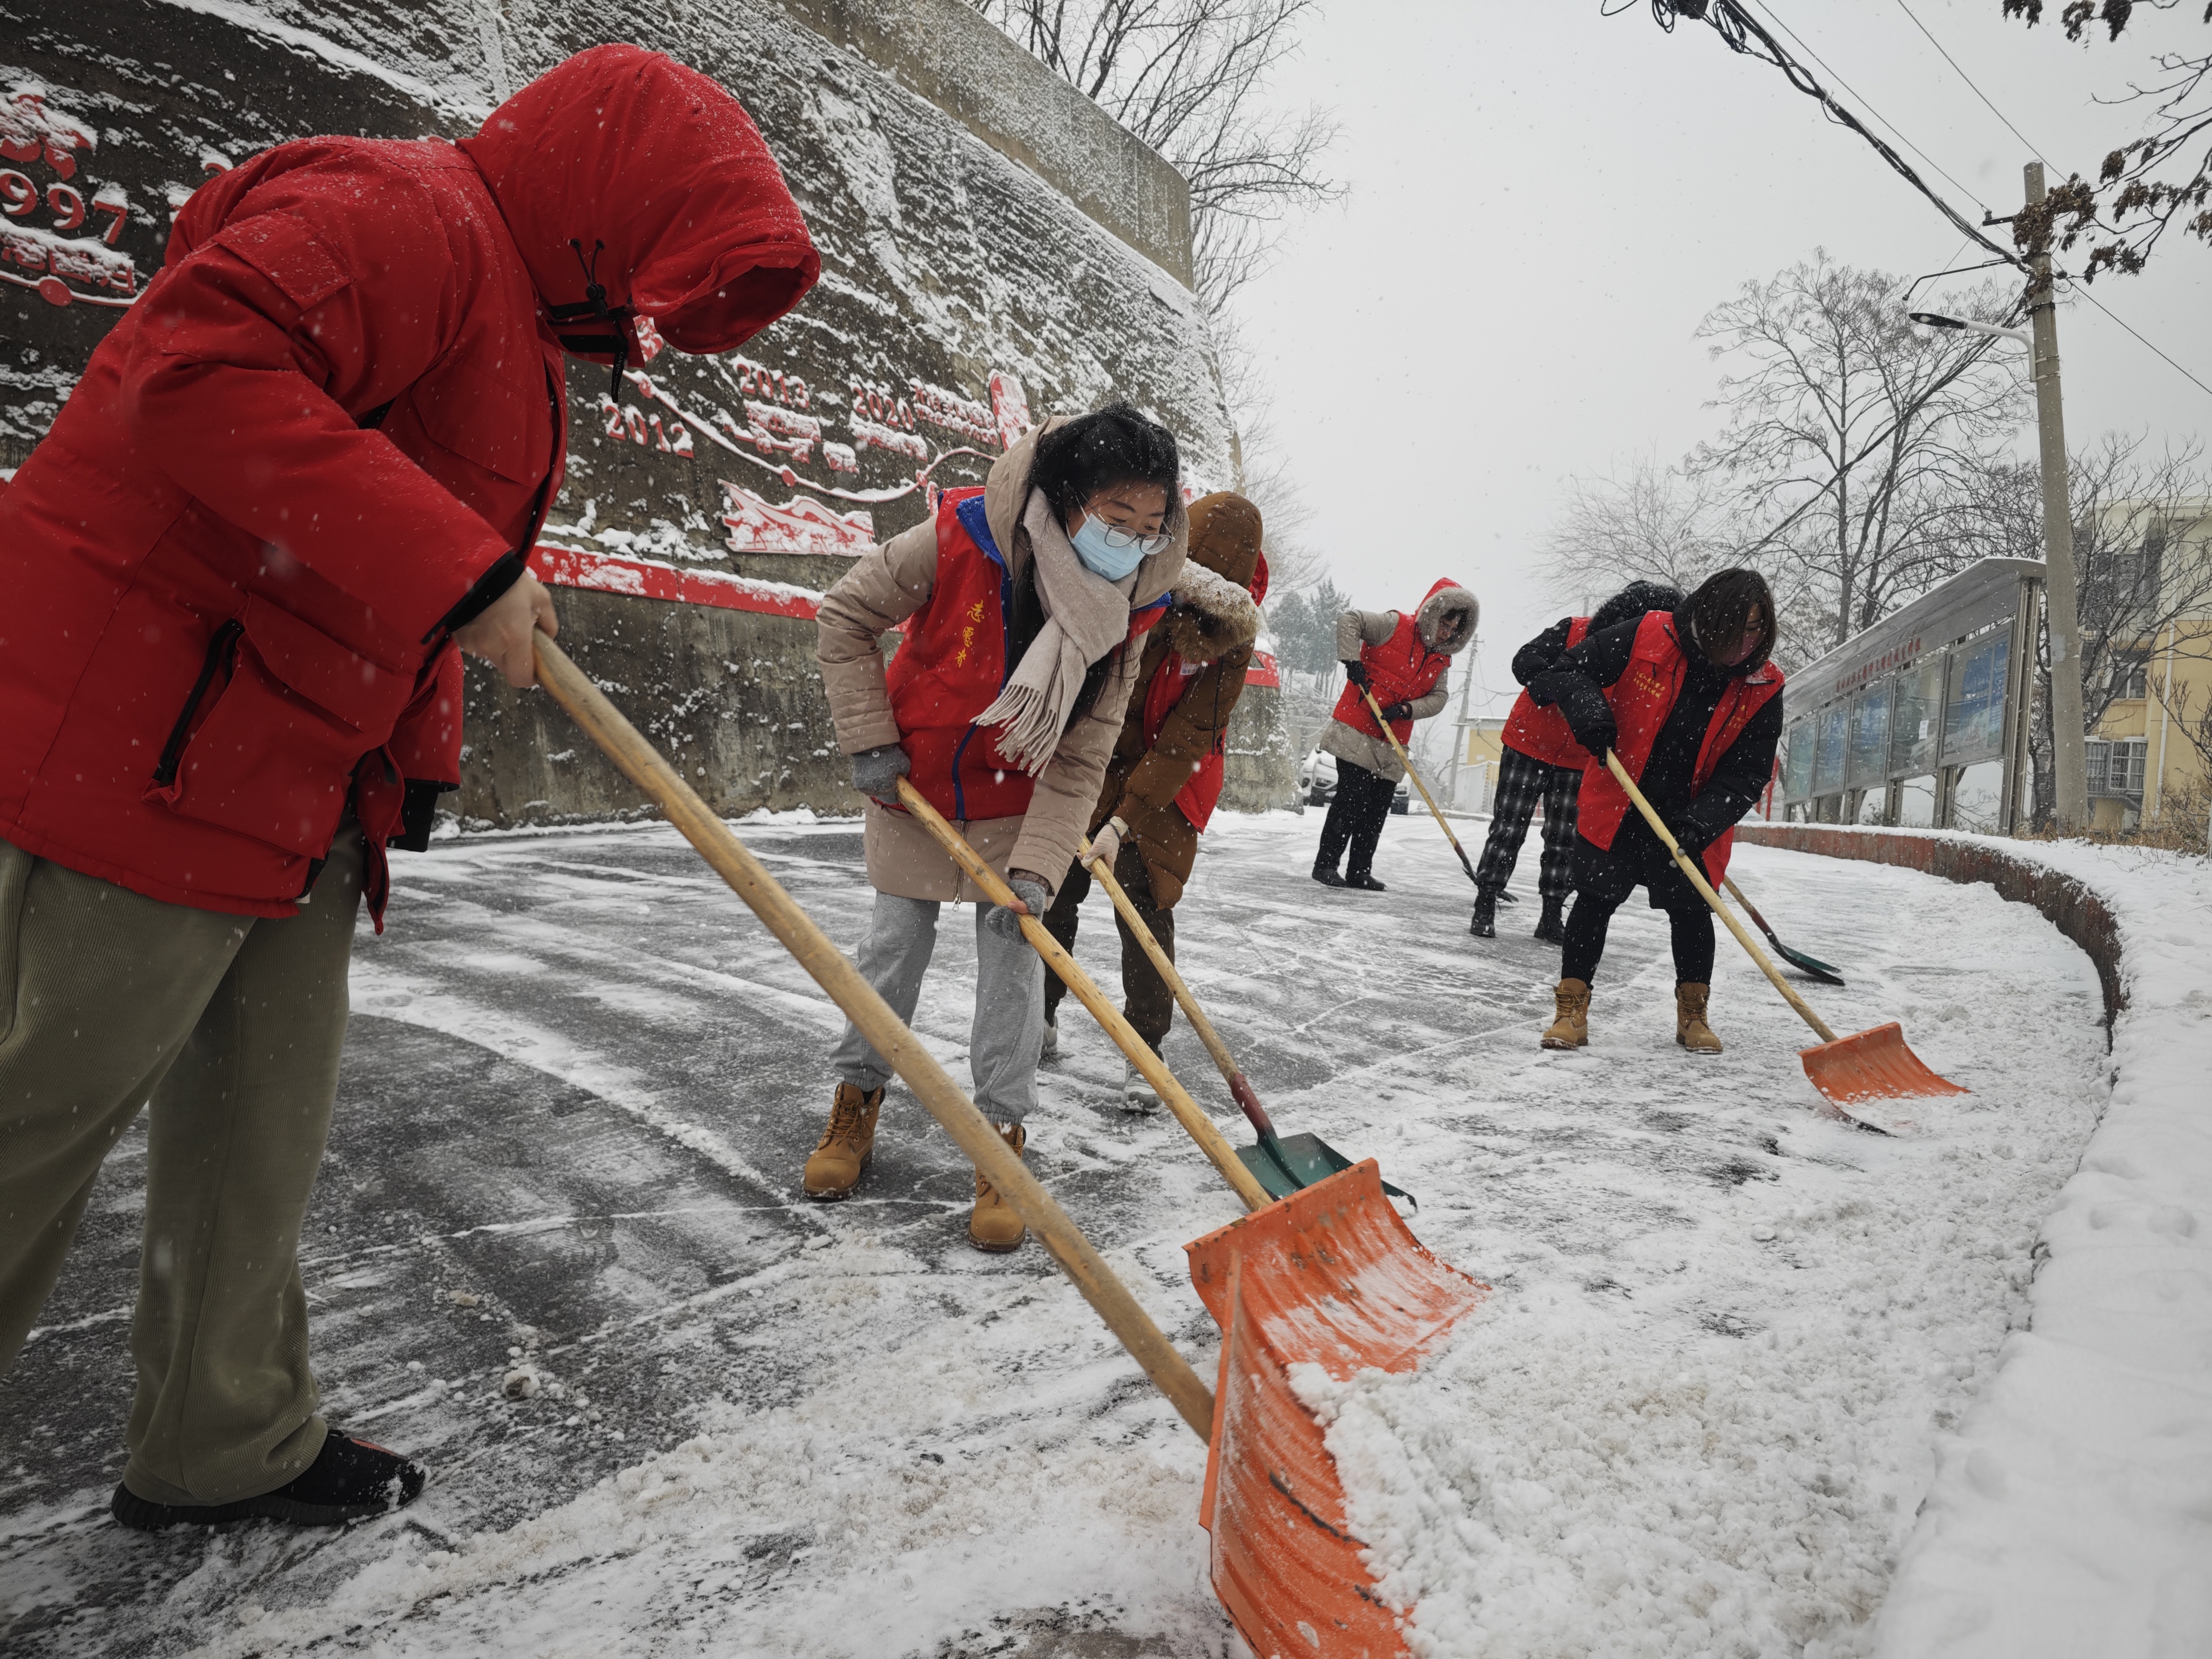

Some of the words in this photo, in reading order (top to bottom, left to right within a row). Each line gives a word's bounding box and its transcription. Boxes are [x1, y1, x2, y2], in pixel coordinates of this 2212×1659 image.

[737, 363, 810, 409] 2013
[852, 387, 914, 430] 2020
[603, 406, 694, 459] 2012
[955, 598, 985, 668] 志愿者
